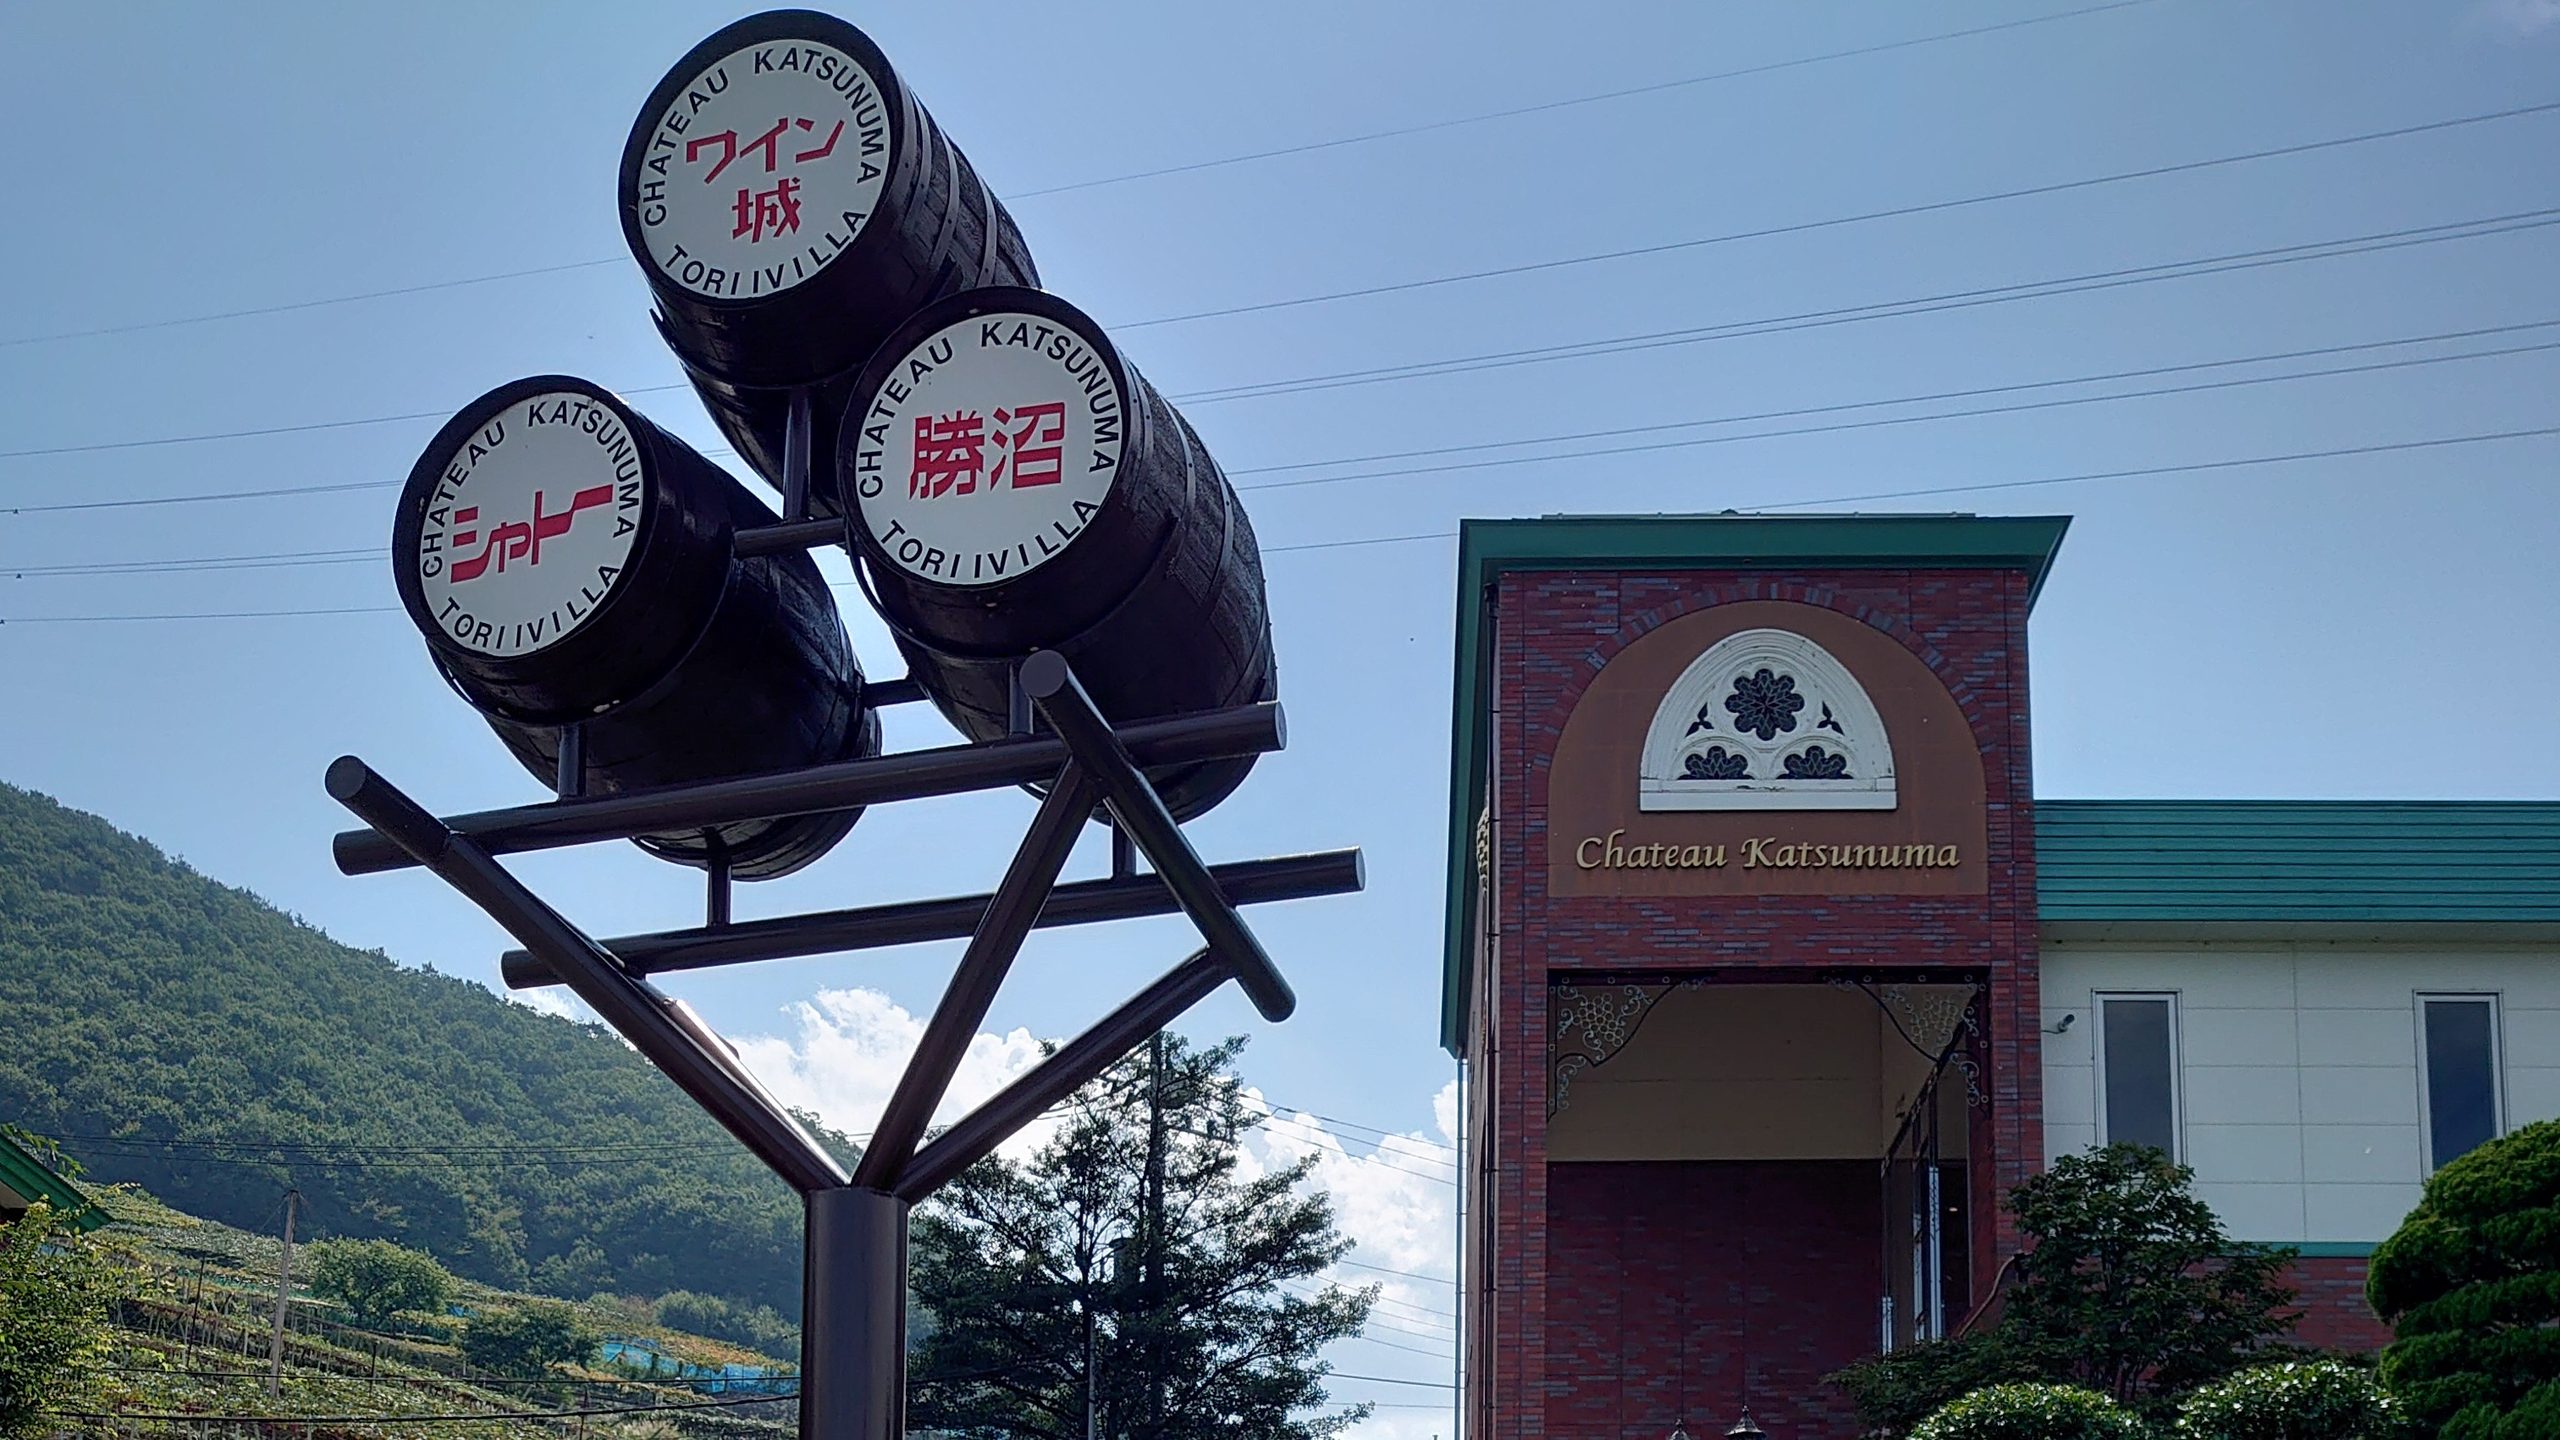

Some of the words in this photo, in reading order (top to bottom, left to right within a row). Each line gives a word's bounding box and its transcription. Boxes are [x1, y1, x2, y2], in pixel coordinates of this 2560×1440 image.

[643, 68, 729, 227] CHATEAU
[754, 47, 885, 184] KATSUNUMA
[686, 117, 845, 184] ワイン
[731, 178, 801, 243] 城
[859, 337, 953, 498] CHATEAU
[981, 321, 1119, 473] KATSUNUMA
[909, 402, 1065, 500] 勝沼
[422, 421, 505, 578] CHATEAU
[528, 400, 640, 538] KATSUNUMA
[450, 484, 614, 583] シャトー
[1576, 829, 1727, 869] Chateau
[1741, 837, 1960, 868] Katsunuma
